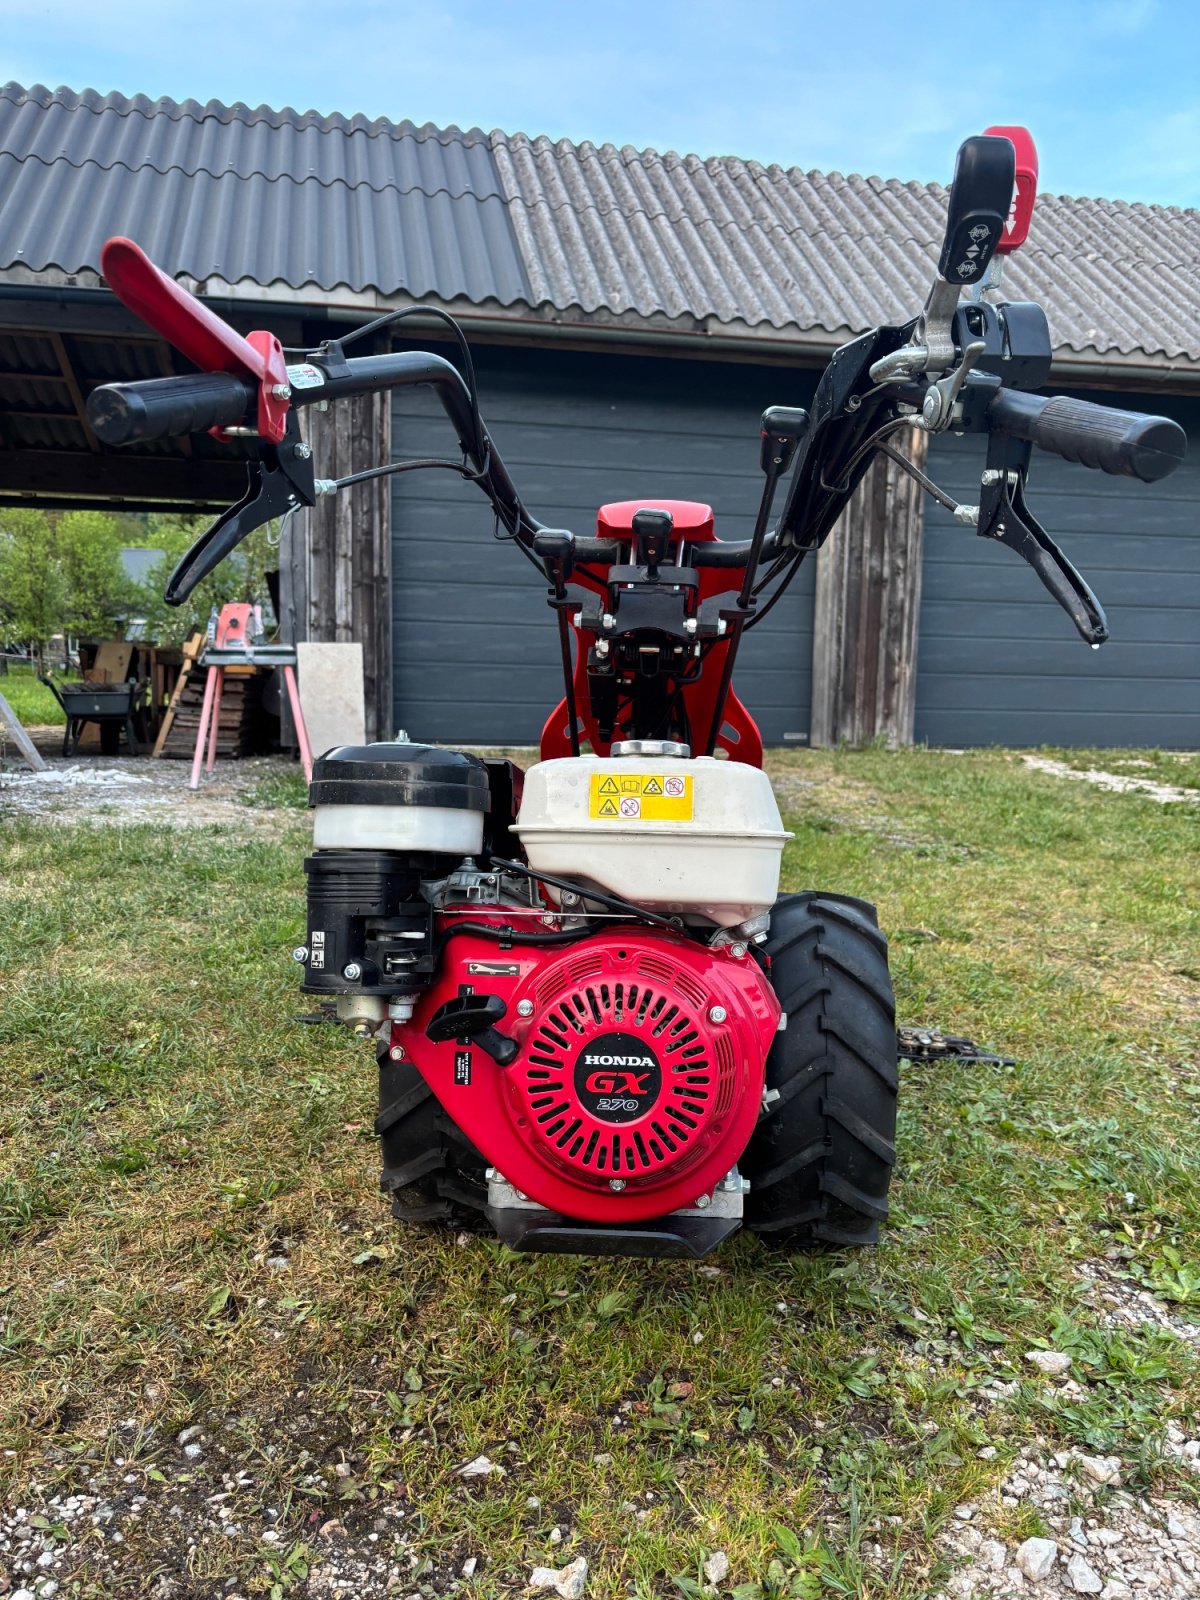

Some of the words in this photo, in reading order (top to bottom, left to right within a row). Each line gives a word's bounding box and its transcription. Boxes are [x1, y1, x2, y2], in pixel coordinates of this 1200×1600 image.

[584, 1055, 656, 1067] HONDA
[585, 1071, 651, 1095] GX
[596, 1098, 639, 1112] 270
